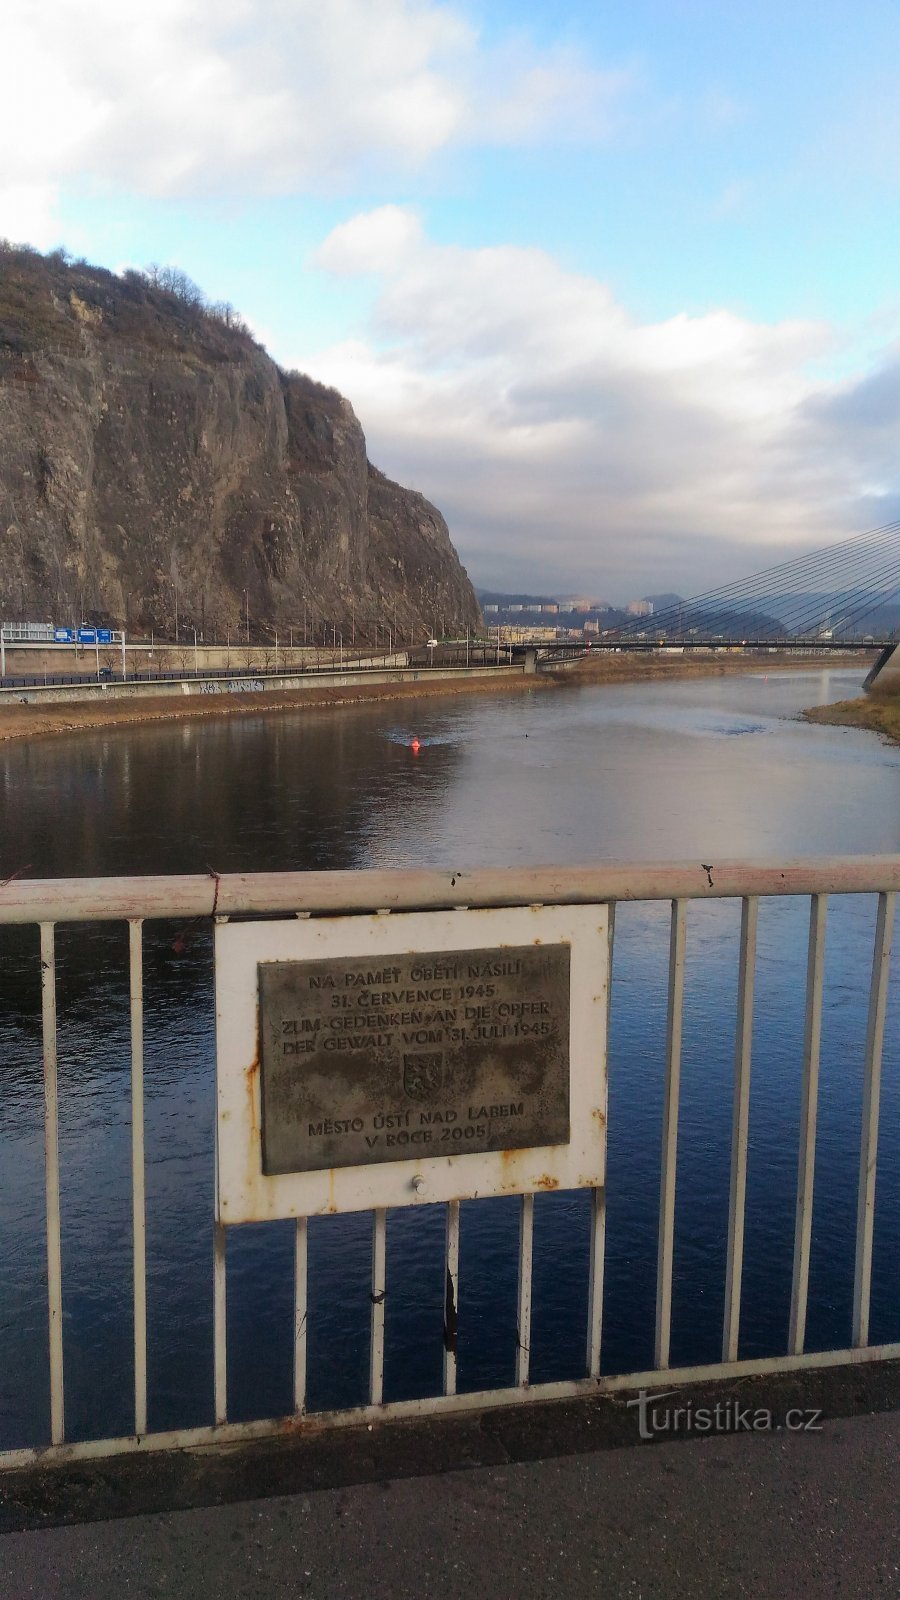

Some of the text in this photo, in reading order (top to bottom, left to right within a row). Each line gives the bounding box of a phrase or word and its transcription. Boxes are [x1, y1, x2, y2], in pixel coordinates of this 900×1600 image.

[308, 976, 336, 989] NA
[331, 984, 496, 1008] 31. ČERVENCE 1945
[281, 1001, 550, 1034] ZUM GEDENKEN AN DIE OPFER
[283, 1022, 550, 1055] DER GEWALT VOM 31. JULI 1945
[308, 1102, 524, 1137] MĚSTO ÚSTÍ NAD LABEM
[365, 1125, 486, 1149] V ROCE 2005
